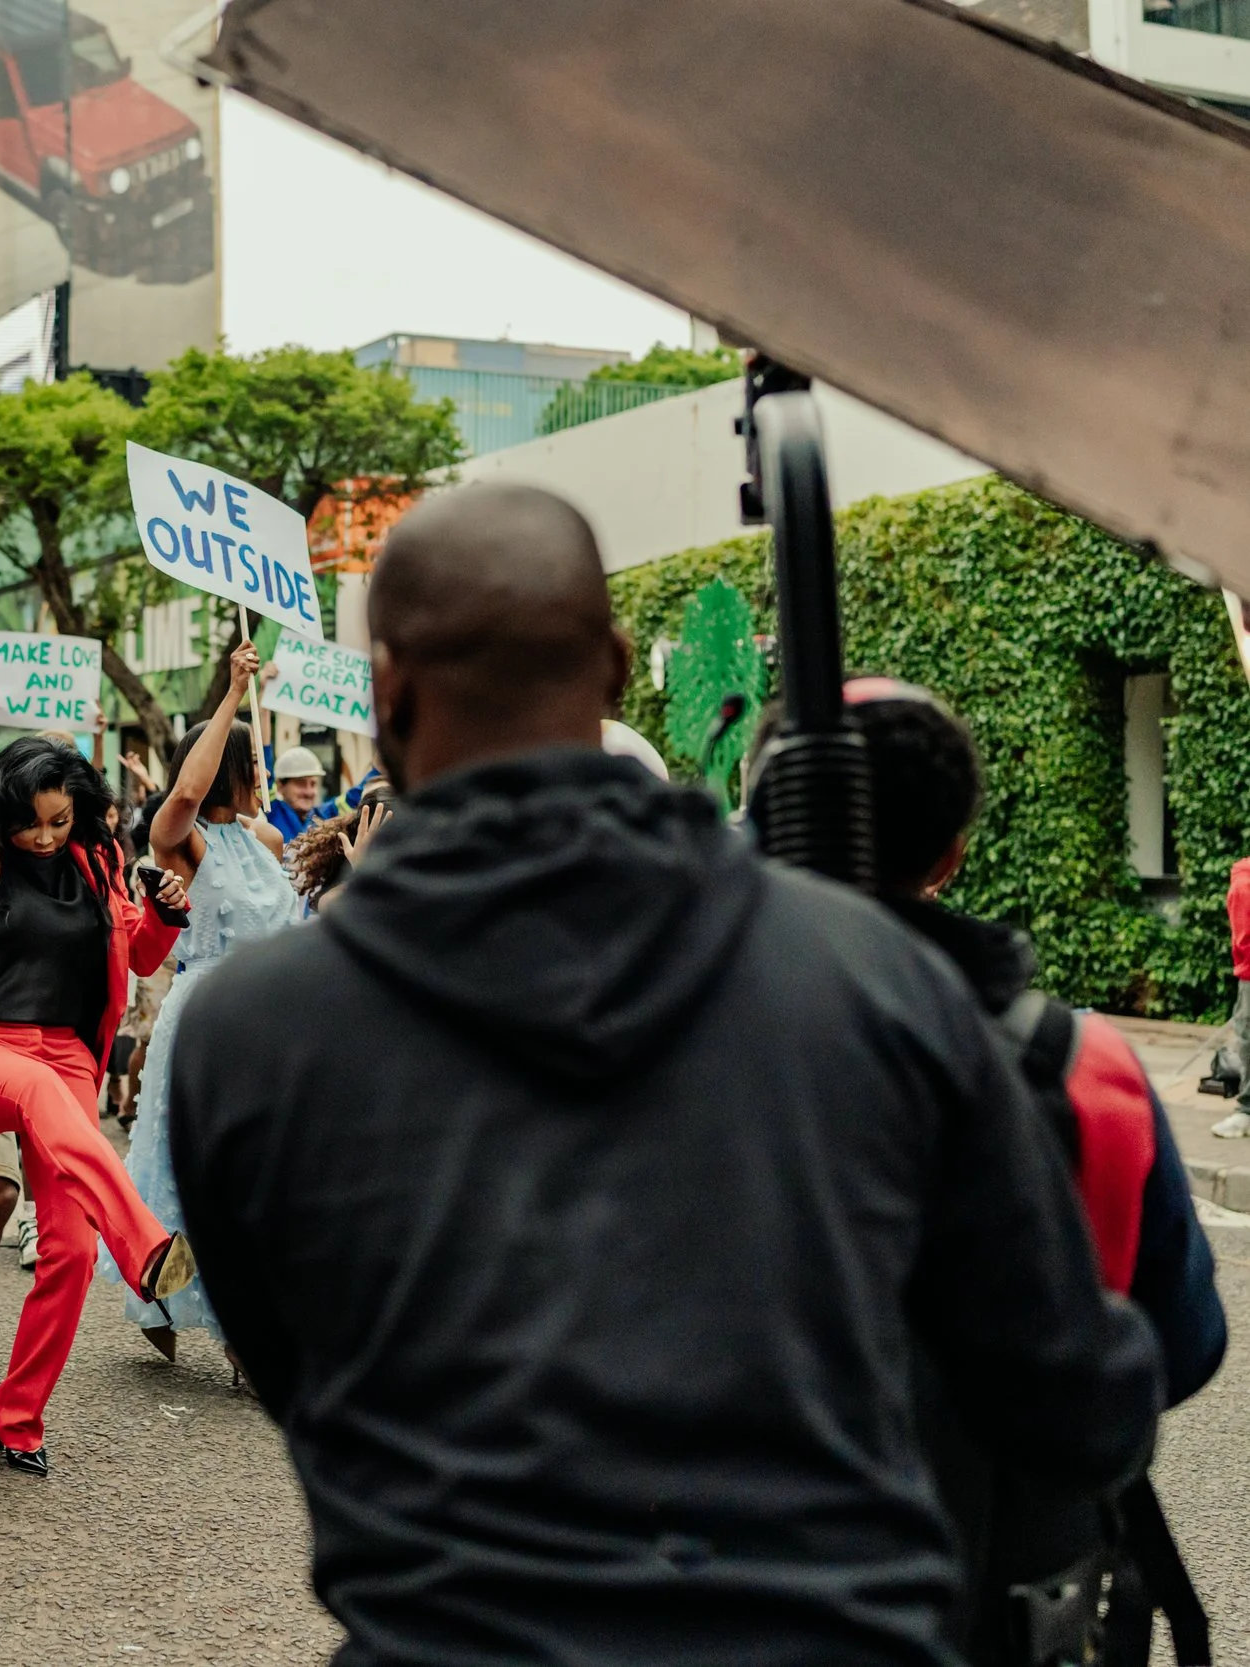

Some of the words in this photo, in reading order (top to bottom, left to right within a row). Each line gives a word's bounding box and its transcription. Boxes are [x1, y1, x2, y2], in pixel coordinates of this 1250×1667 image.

[167, 469, 251, 533] WE
[147, 516, 316, 622] OUTSIDE
[60, 645, 99, 670] LOVE
[279, 638, 328, 662] MAKE
[26, 672, 73, 691] AND
[302, 661, 374, 692] GREAT
[6, 696, 87, 721] WINE
[276, 681, 372, 720] AGAIN
